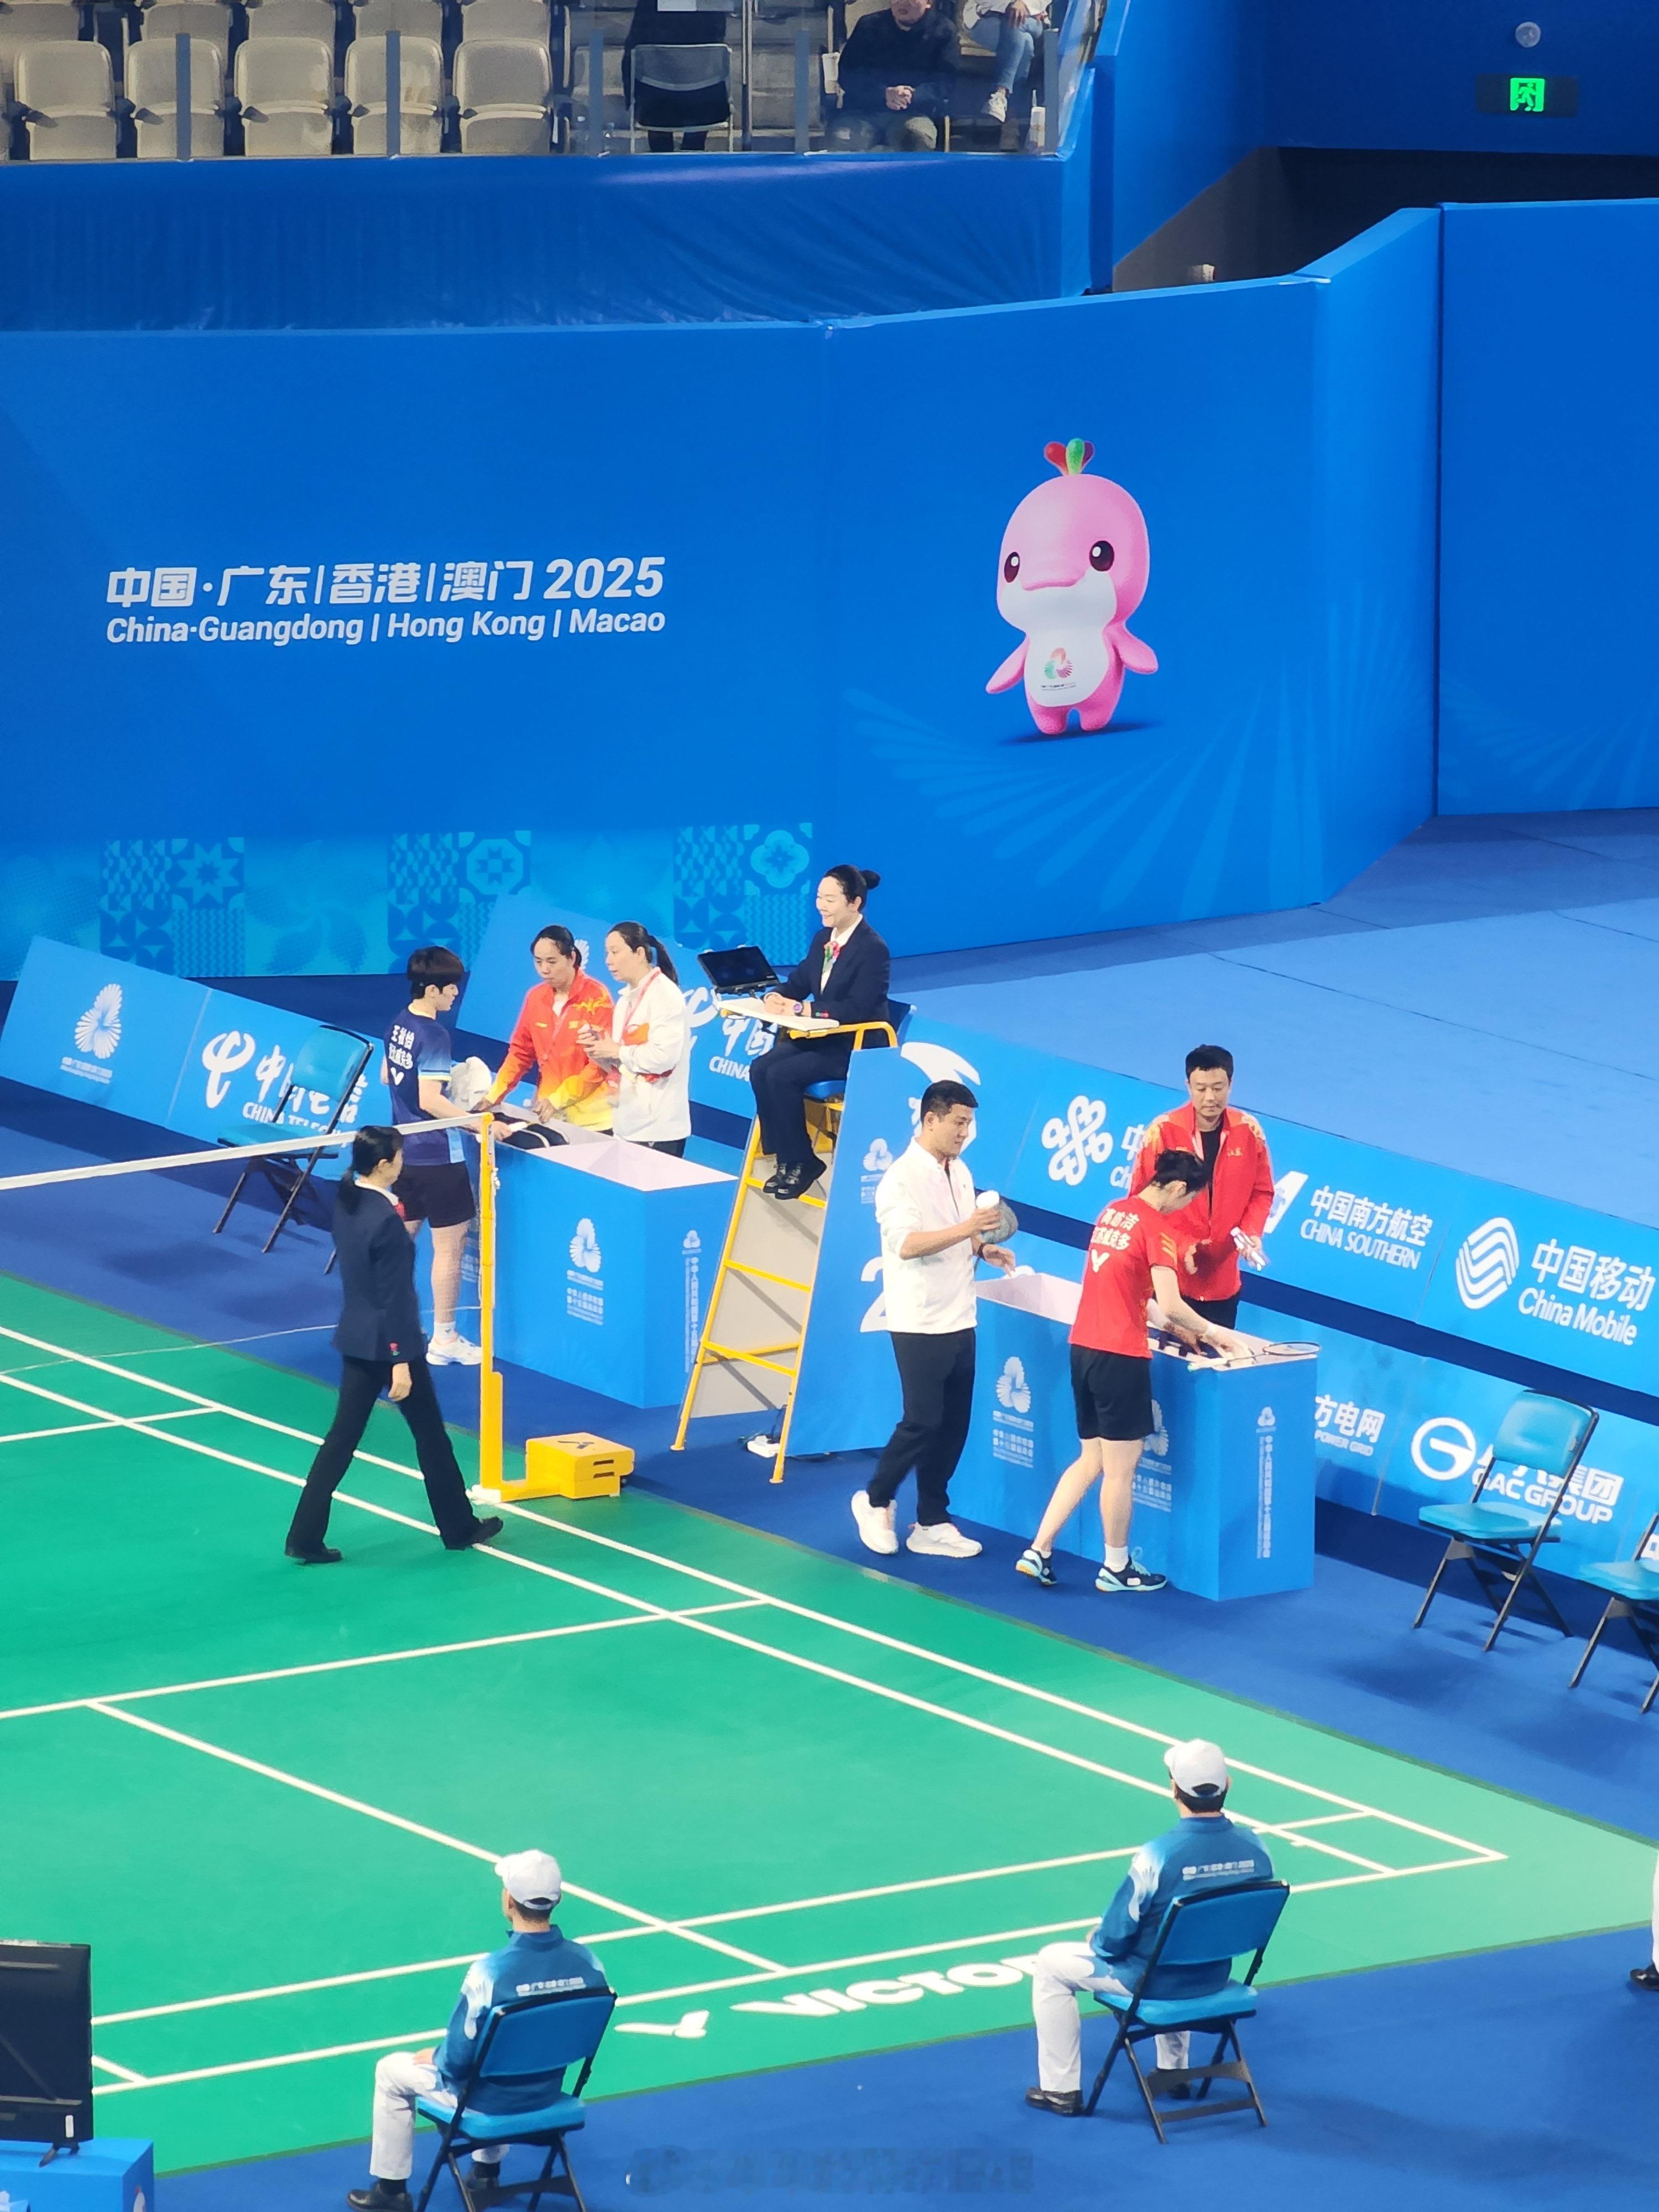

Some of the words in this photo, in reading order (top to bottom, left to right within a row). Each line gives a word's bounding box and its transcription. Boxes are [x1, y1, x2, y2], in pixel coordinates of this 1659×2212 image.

[543, 556, 665, 599] 2025
[387, 611, 464, 643] Hong
[472, 611, 546, 641] Kong
[569, 608, 665, 634] Macao
[1310, 1185, 1433, 1246] 中国南方航空
[1300, 1219, 1343, 1248] CHINA
[1344, 1231, 1421, 1270] SOUTHERN
[1531, 1238, 1656, 1311] 中国移动
[1519, 1287, 1573, 1326] China
[1572, 1303, 1637, 1345] Mobile
